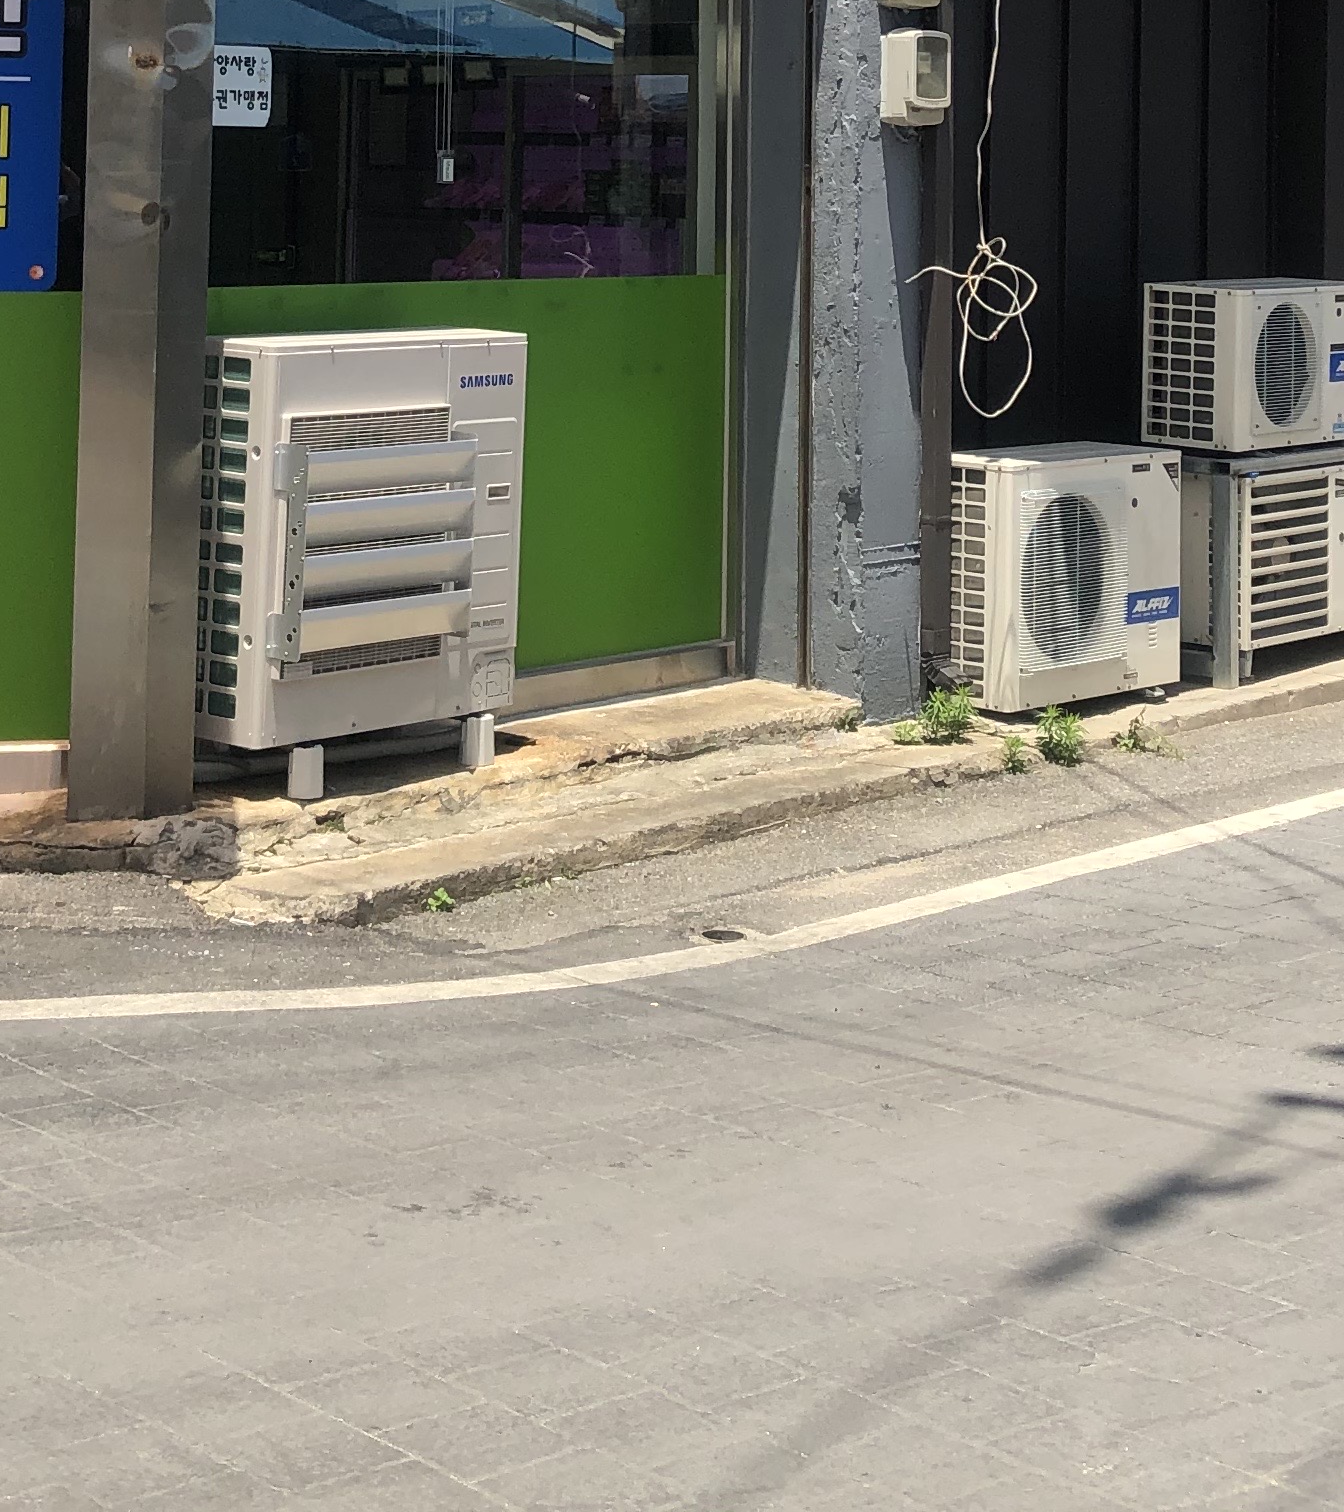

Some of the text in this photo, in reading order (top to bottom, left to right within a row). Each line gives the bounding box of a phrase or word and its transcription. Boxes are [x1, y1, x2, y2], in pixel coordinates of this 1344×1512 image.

[214, 54, 257, 76] 양사랑
[214, 88, 269, 111] 권가맹점
[460, 373, 514, 389] SAMSUNG
